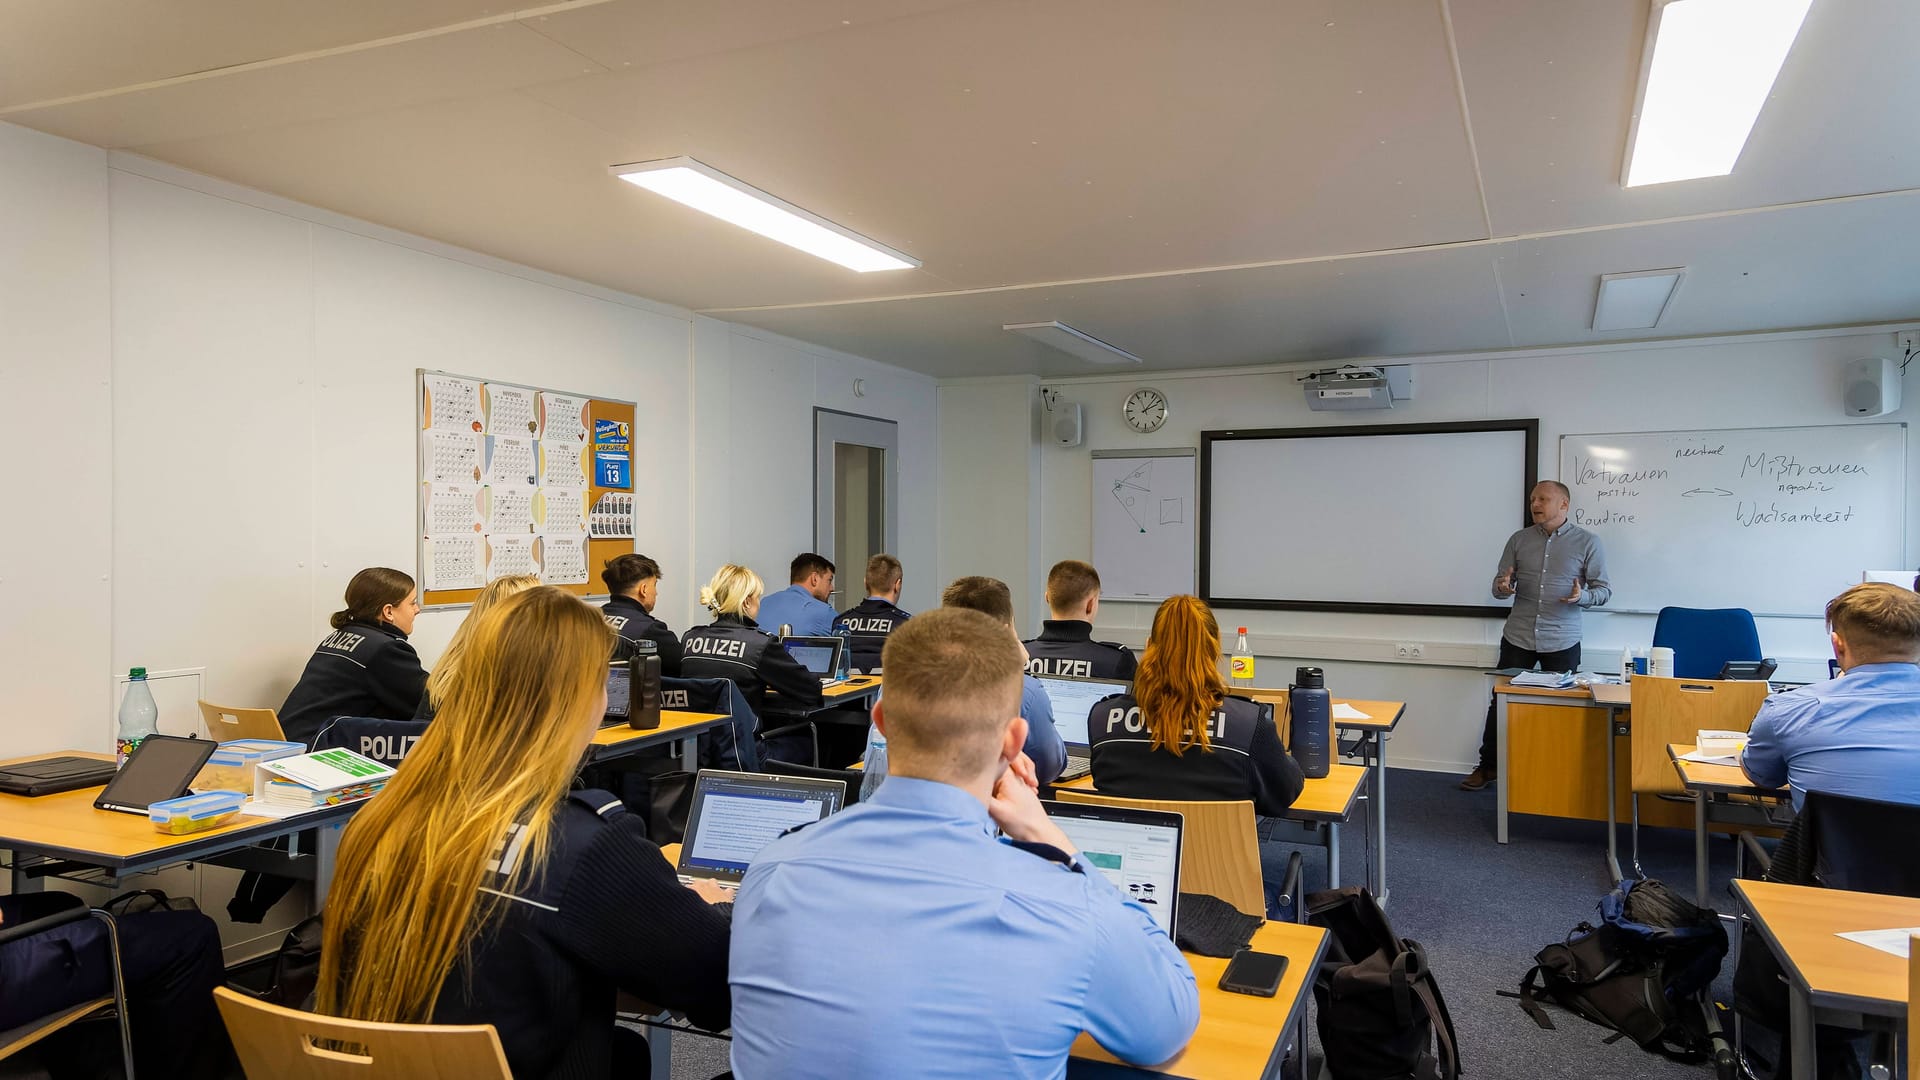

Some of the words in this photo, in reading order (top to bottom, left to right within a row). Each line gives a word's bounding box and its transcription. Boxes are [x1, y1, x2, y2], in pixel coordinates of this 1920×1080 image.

[606, 469, 620, 483] 13
[322, 630, 366, 652] OLIZEI
[684, 637, 746, 658] POLIZEI
[360, 735, 422, 760] POLIZ
